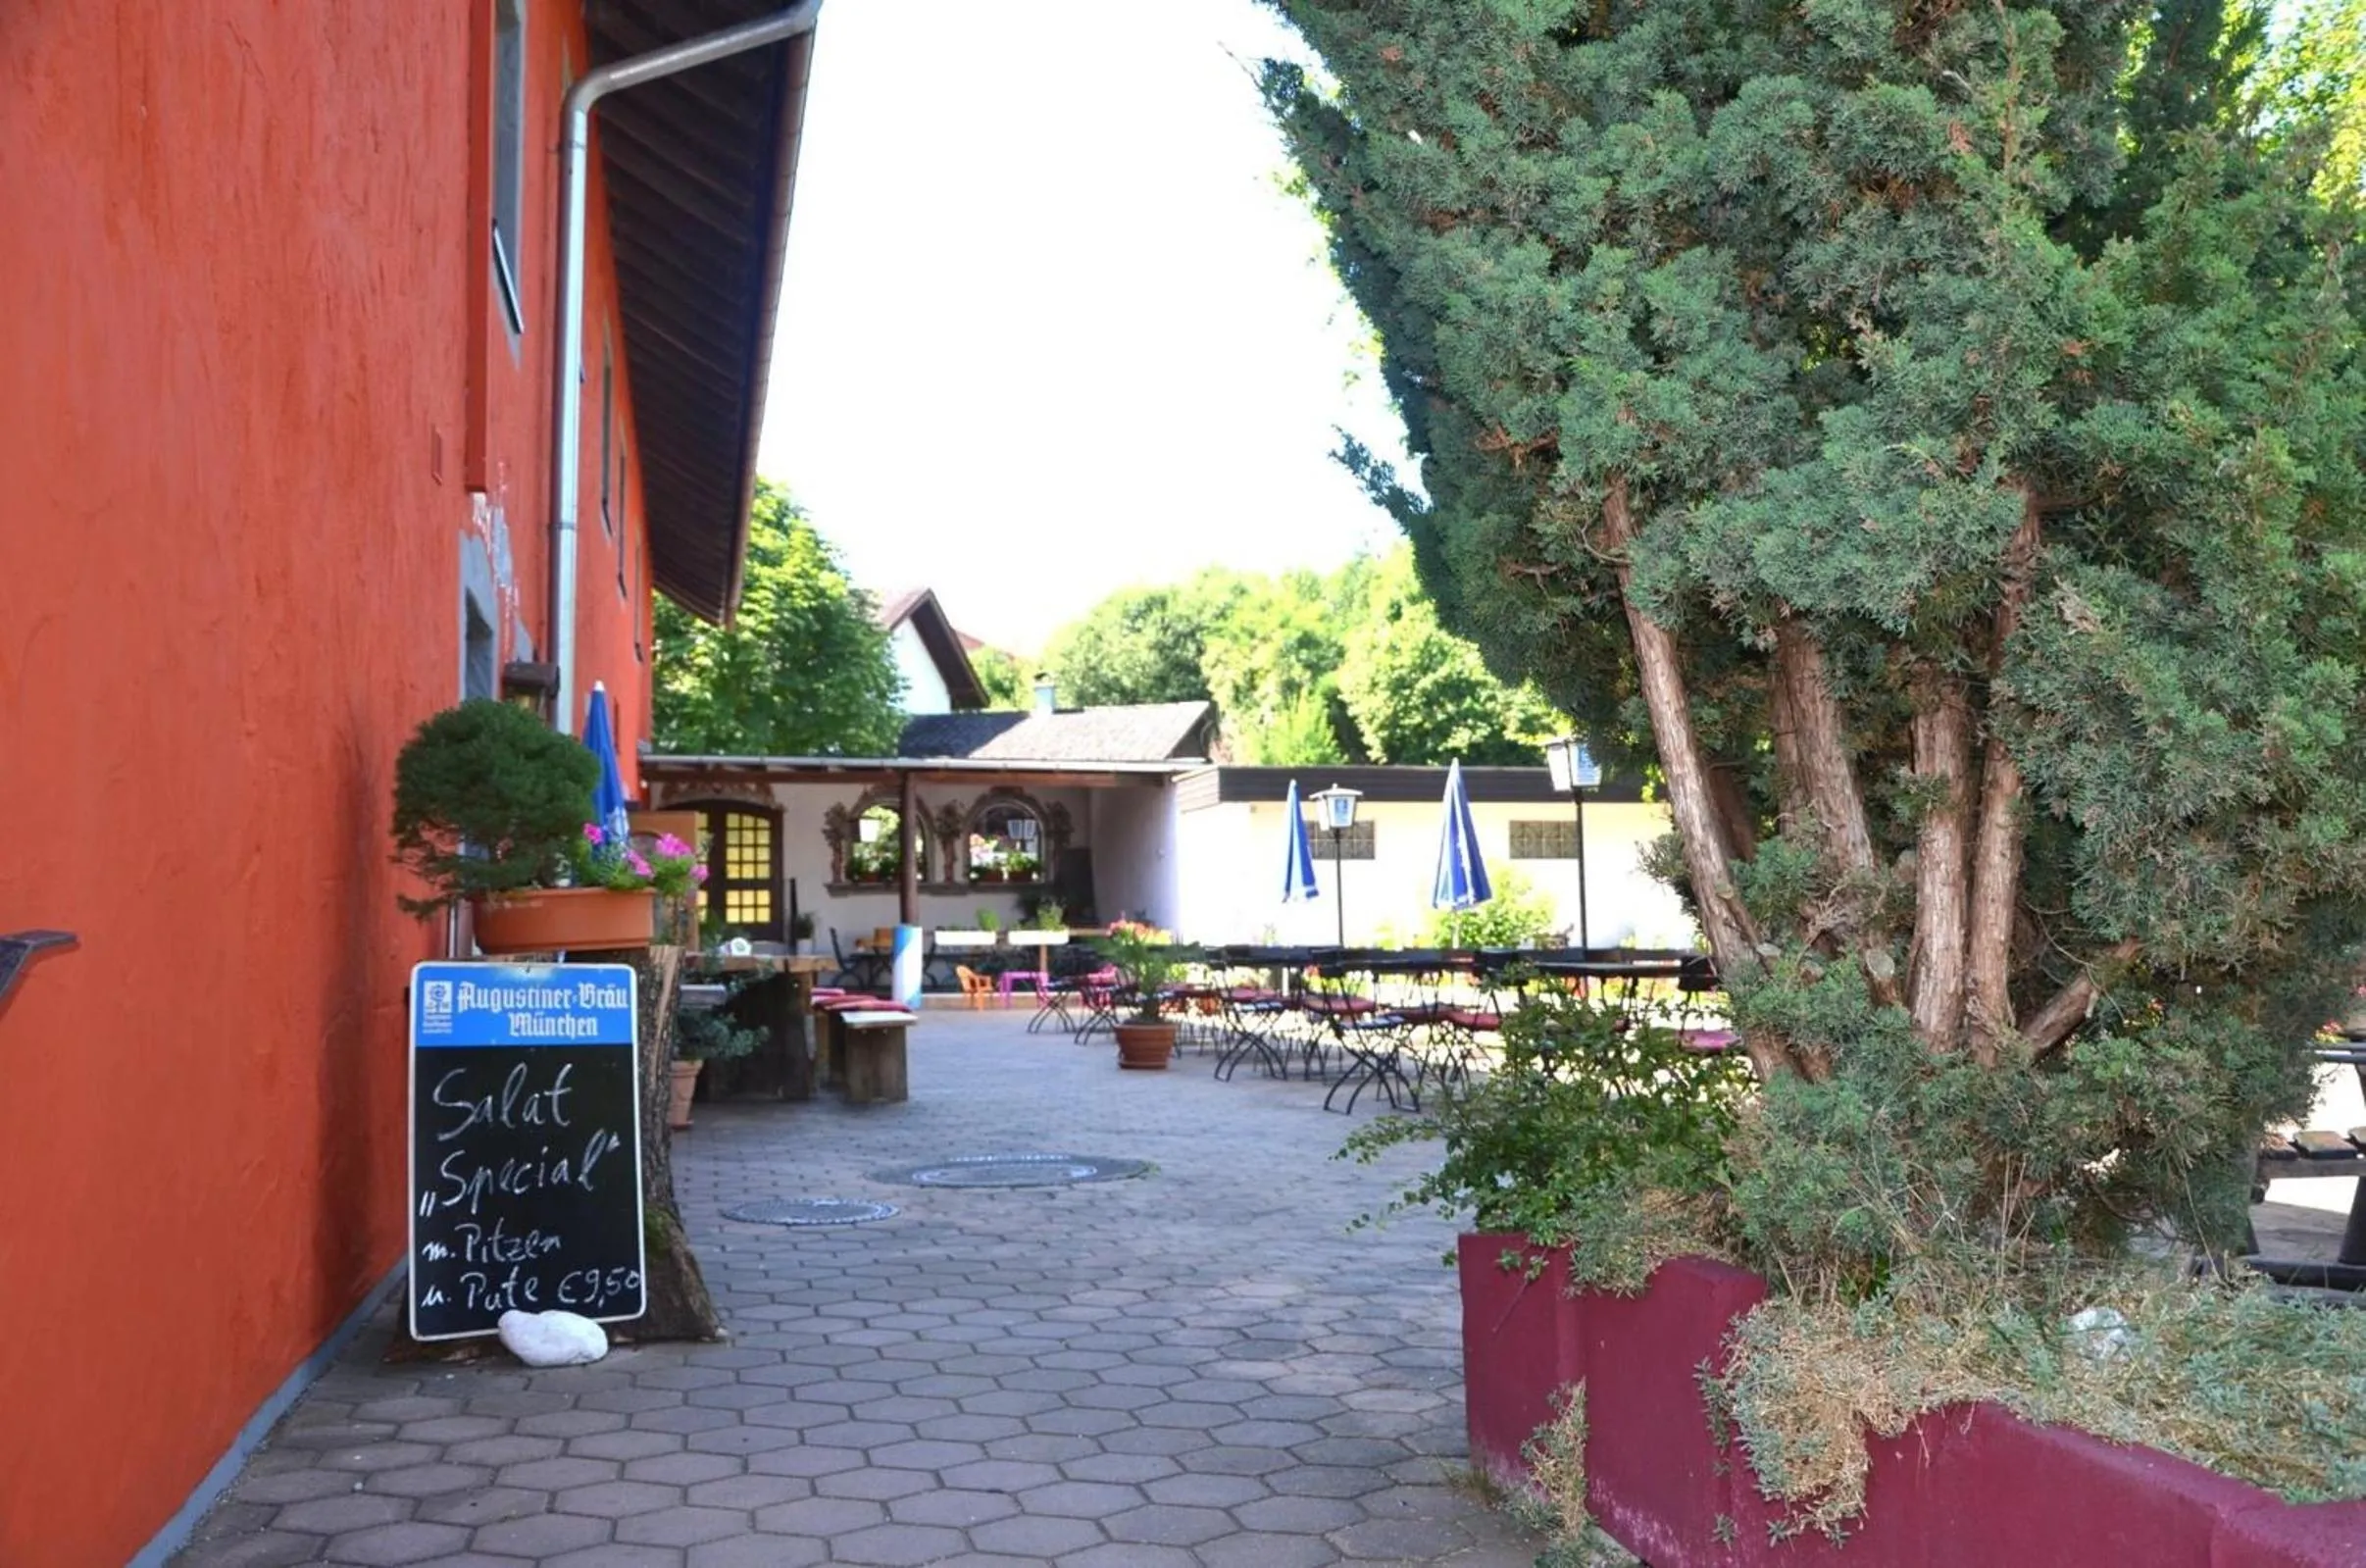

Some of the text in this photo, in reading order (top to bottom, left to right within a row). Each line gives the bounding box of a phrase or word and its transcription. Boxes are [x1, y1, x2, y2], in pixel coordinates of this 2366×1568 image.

[508, 1012, 599, 1039] München
[432, 1062, 573, 1141] Salat
[459, 1265, 538, 1310] Pute
